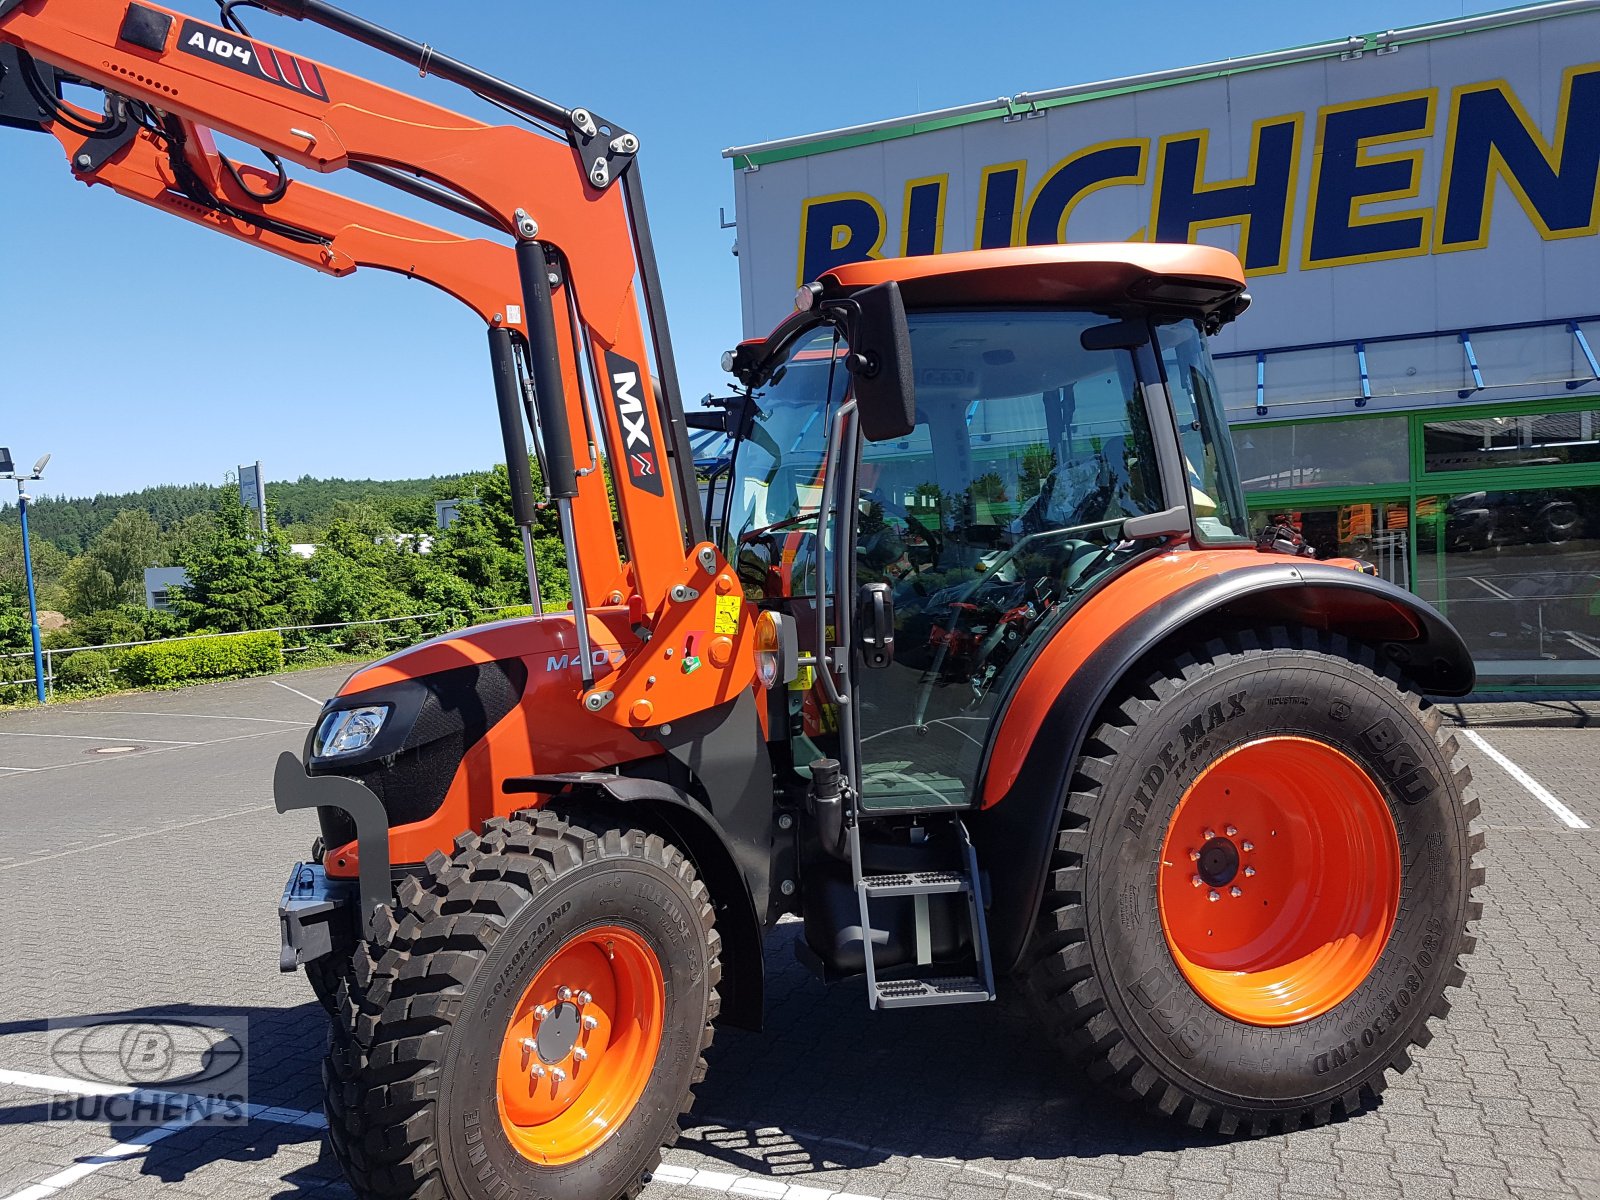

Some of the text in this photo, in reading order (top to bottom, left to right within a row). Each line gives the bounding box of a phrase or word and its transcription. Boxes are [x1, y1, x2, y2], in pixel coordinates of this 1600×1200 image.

[187, 31, 252, 66] A104
[612, 370, 651, 450] MX
[1123, 690, 1247, 840] RIDE MAX
[1361, 718, 1439, 804] BKT
[546, 900, 573, 926] IND
[1129, 967, 1209, 1058] BKT
[1312, 1036, 1360, 1076] IND
